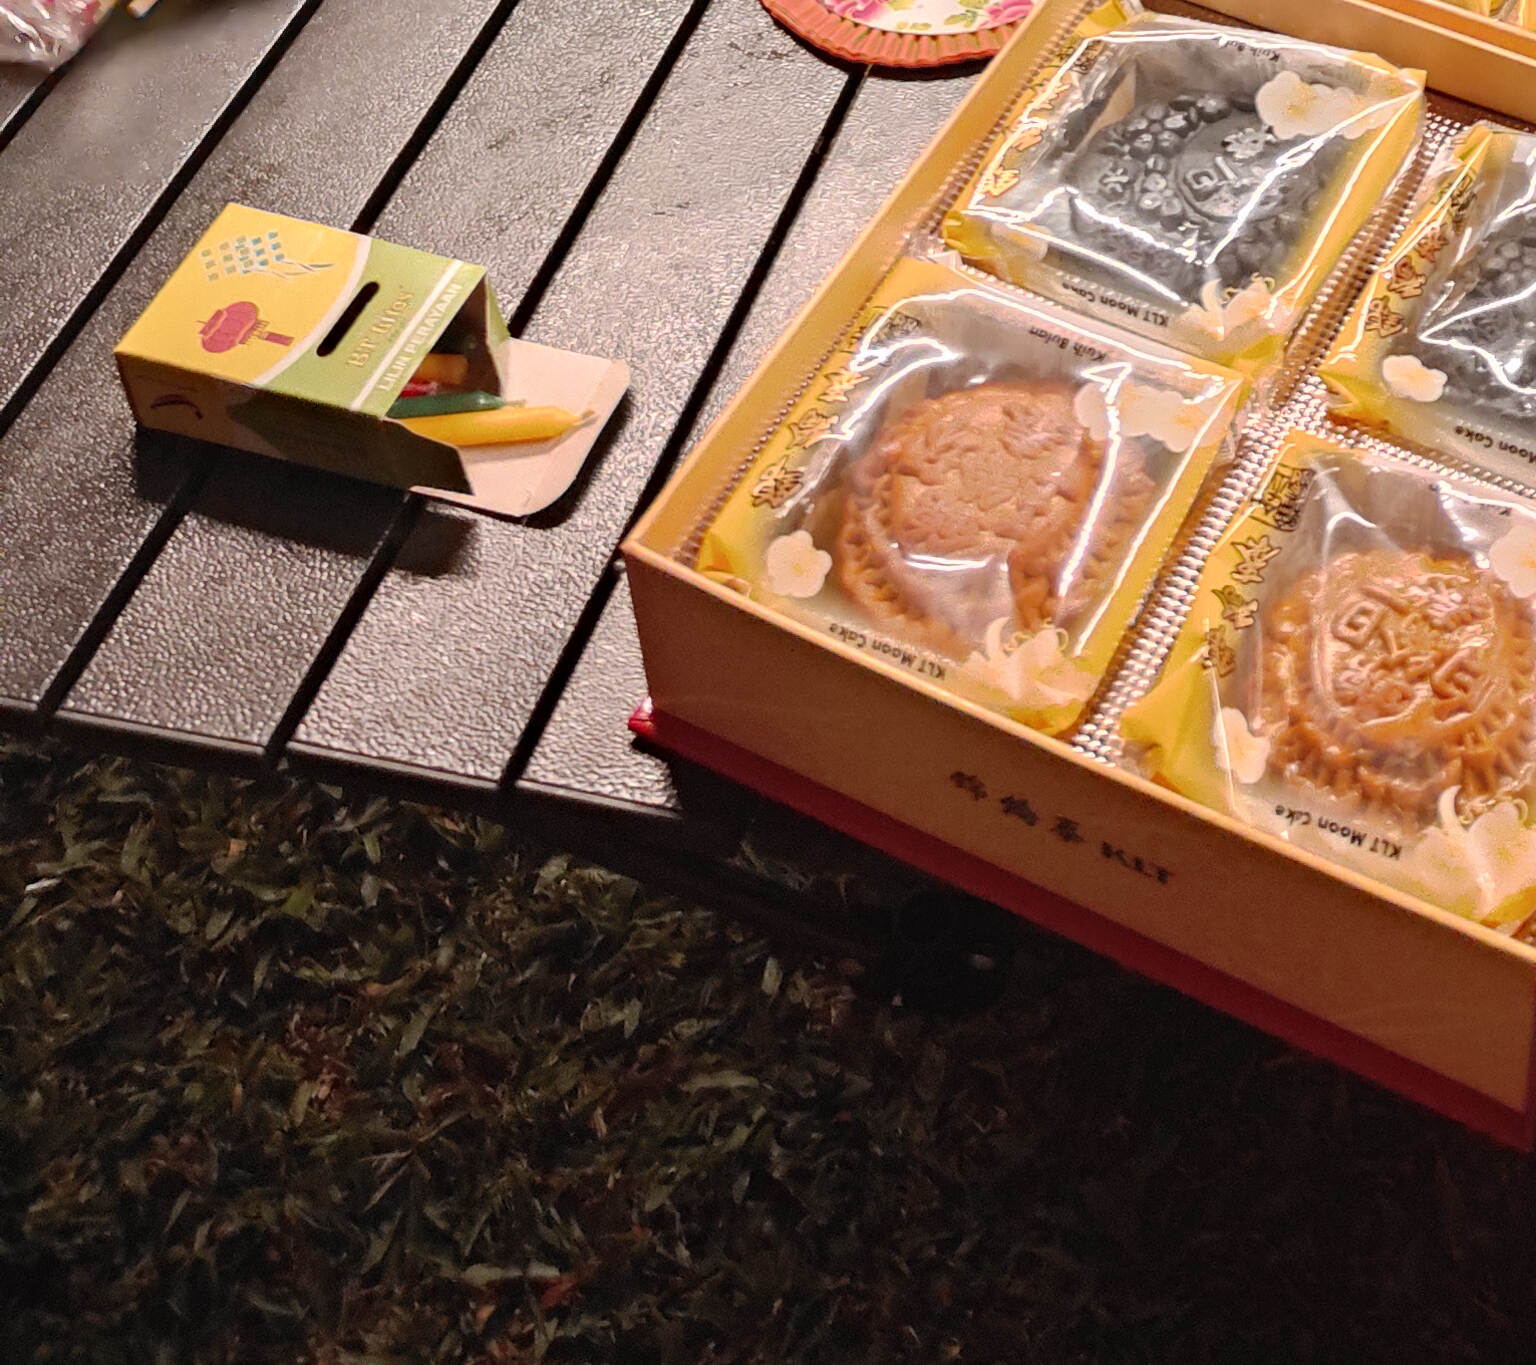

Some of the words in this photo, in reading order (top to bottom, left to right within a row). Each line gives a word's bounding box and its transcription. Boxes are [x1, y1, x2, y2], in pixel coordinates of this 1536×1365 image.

[1061, 281, 1096, 303] Cake
[1100, 295, 1140, 318] Moon
[1142, 308, 1170, 328] KLT
[378, 355, 412, 391] LILIN
[404, 282, 463, 354] PERAYAAN
[1454, 425, 1494, 449] Cake
[828, 622, 867, 648] Cake
[871, 639, 917, 669] Moon
[917, 658, 947, 681] KLT
[1274, 804, 1312, 826] Cake
[1317, 815, 1368, 847] Moon
[1369, 836, 1403, 861] KLT
[1102, 840, 1174, 885] KLT
